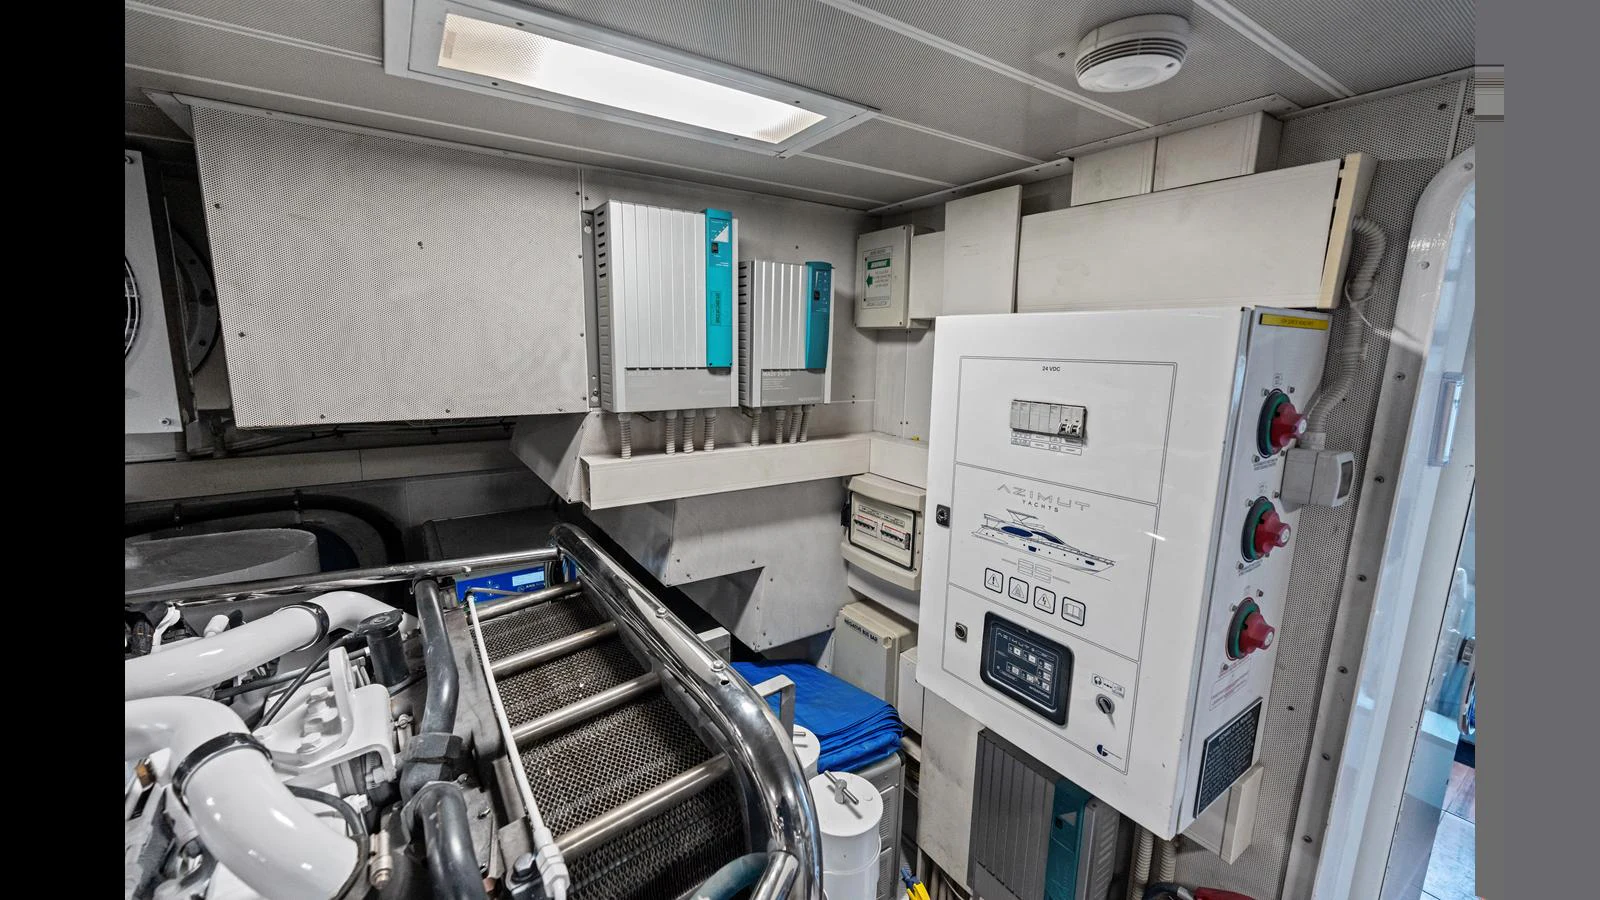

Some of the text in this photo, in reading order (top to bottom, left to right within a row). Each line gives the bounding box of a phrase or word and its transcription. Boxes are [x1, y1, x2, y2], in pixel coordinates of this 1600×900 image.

[997, 483, 1091, 511] AZIMUT
[1022, 500, 1059, 512] YACHTS
[997, 632, 1030, 649] AZIMUT
